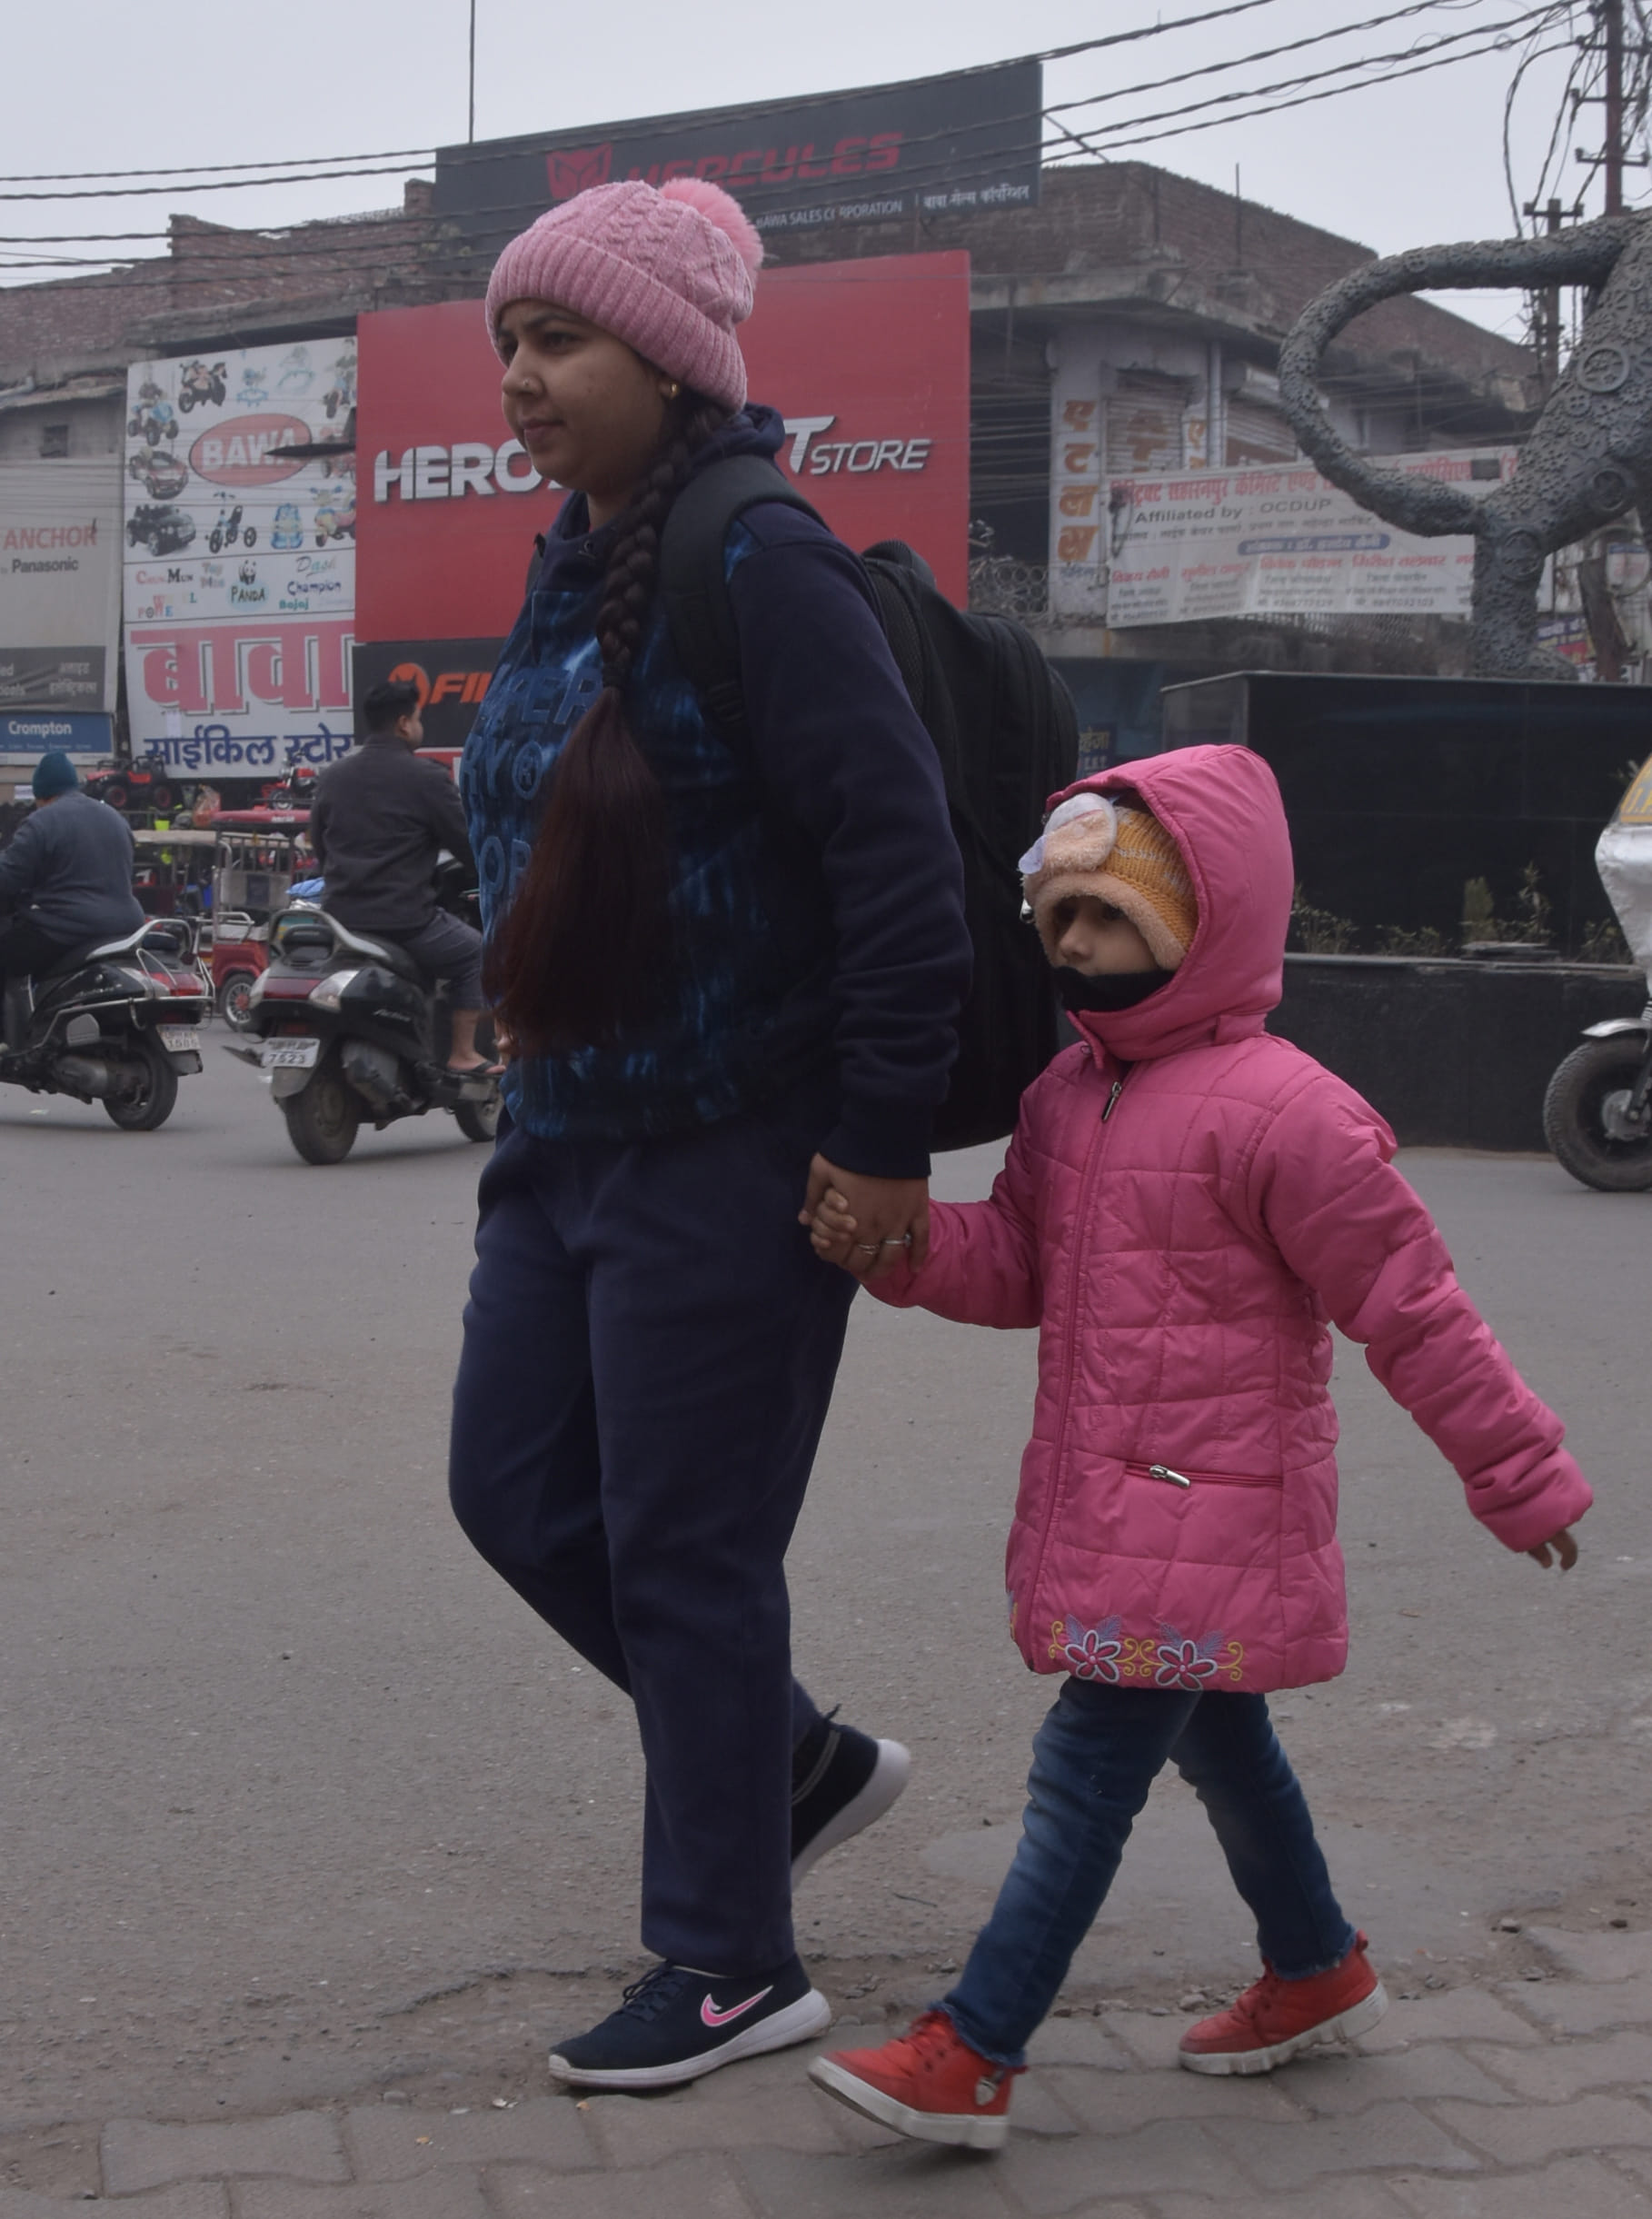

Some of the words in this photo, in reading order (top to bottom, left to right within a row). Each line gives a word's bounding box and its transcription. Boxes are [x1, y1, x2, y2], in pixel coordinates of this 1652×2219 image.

[790, 209, 822, 224] SALES
[374, 438, 542, 502] HERO
[810, 439, 932, 475] STORE
[1135, 508, 1215, 524] Affiliated
[1221, 506, 1243, 520] by
[1259, 498, 1332, 513] OCDUP
[4, 524, 97, 551] ANCHOR
[12, 556, 79, 573] Panasonic
[231, 585, 265, 603] PANDA
[287, 581, 342, 596] Champion
[8, 721, 73, 739] Crompton
[143, 724, 278, 770] साईकिल
[282, 721, 355, 768] स्टोर
